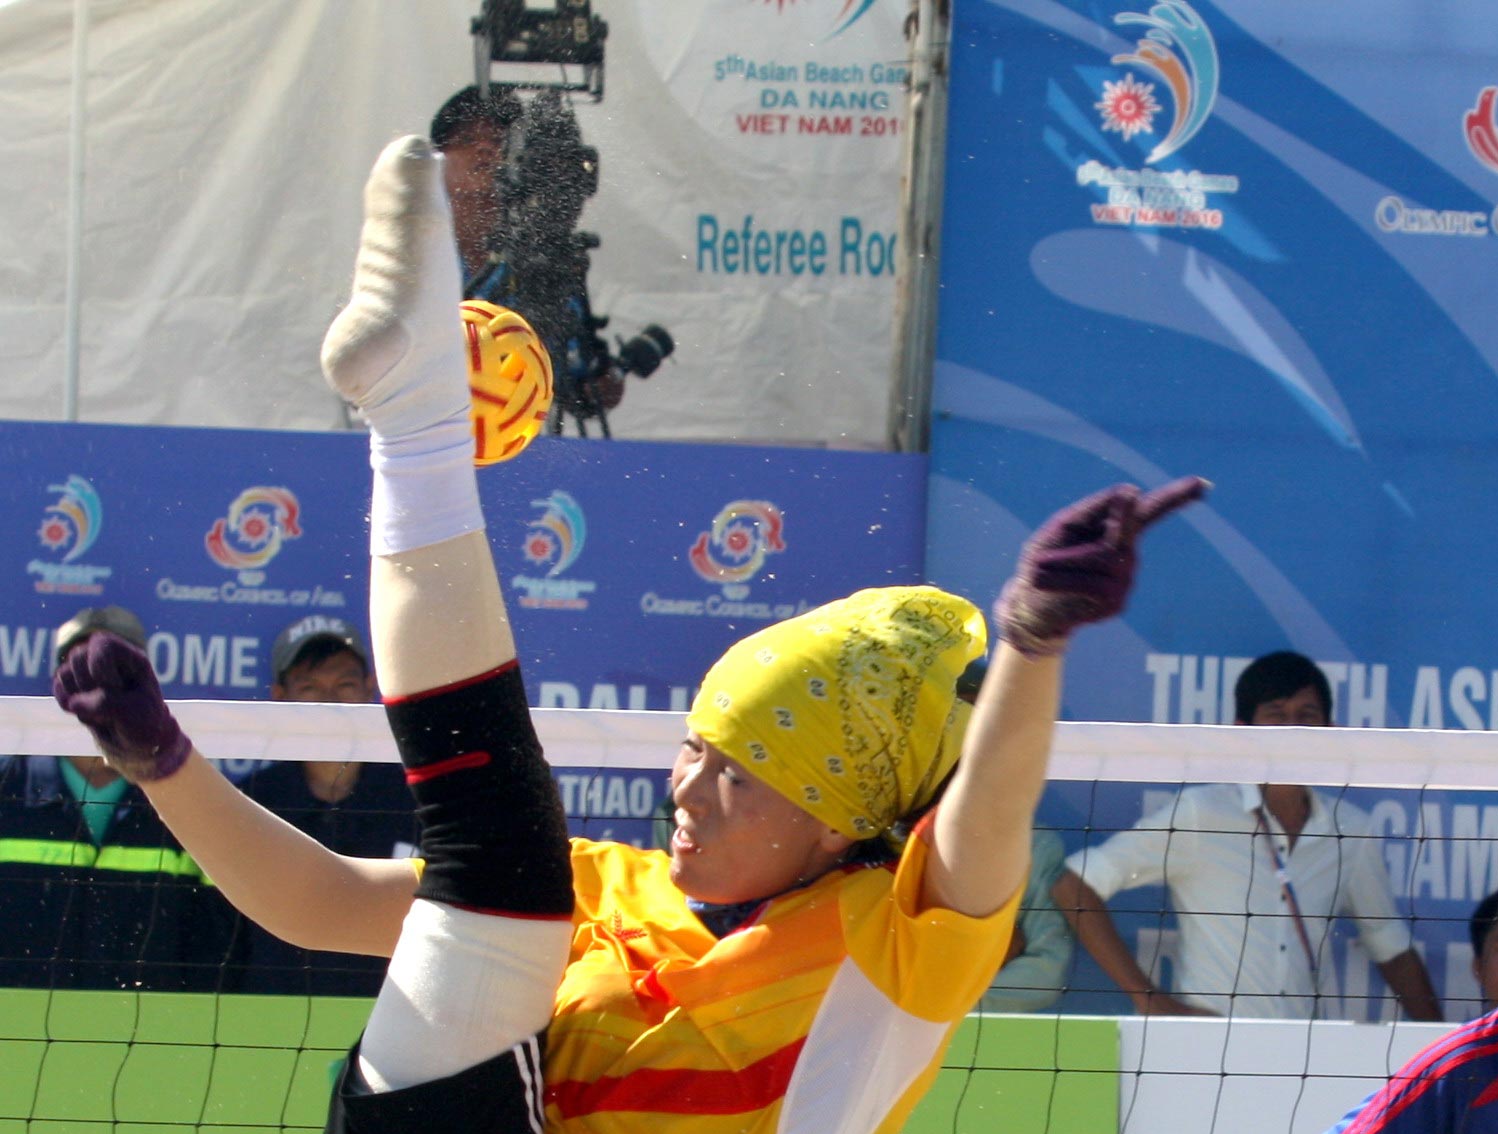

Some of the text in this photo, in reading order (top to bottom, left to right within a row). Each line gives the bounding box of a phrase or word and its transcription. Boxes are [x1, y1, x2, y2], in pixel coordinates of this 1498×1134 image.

[745, 62, 798, 83] Asian
[804, 63, 864, 84] Beach
[759, 89, 890, 111] DA NANG
[736, 115, 908, 137] VIET NAM 201
[697, 214, 827, 275] Referee
